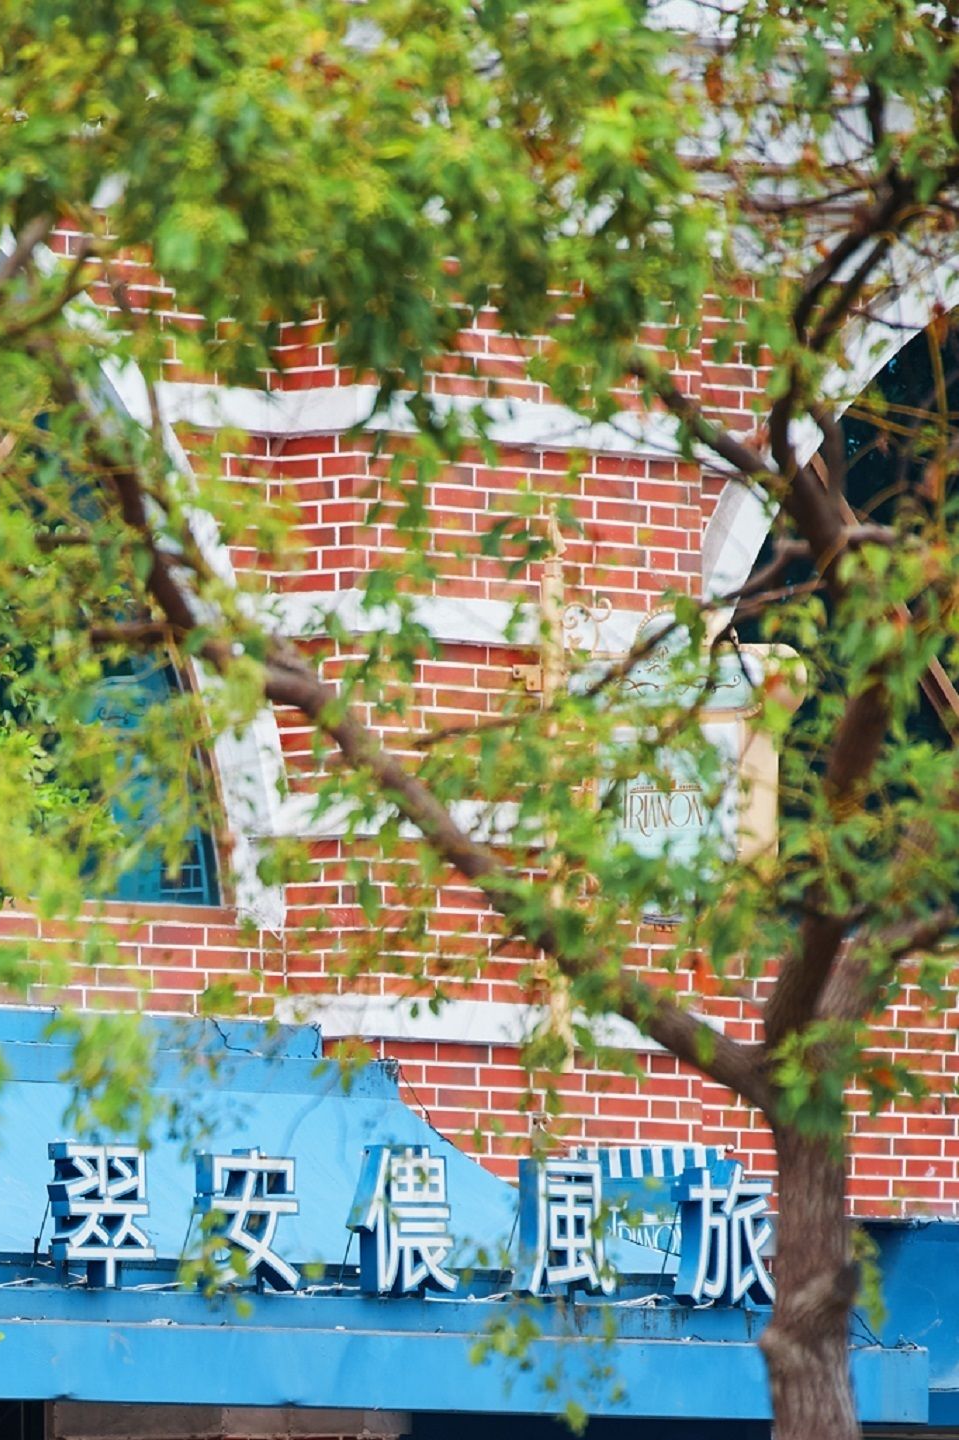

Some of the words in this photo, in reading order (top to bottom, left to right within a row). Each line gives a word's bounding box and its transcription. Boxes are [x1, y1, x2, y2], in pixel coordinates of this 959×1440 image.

[58, 1143, 776, 1301] 翠安儂風旅
